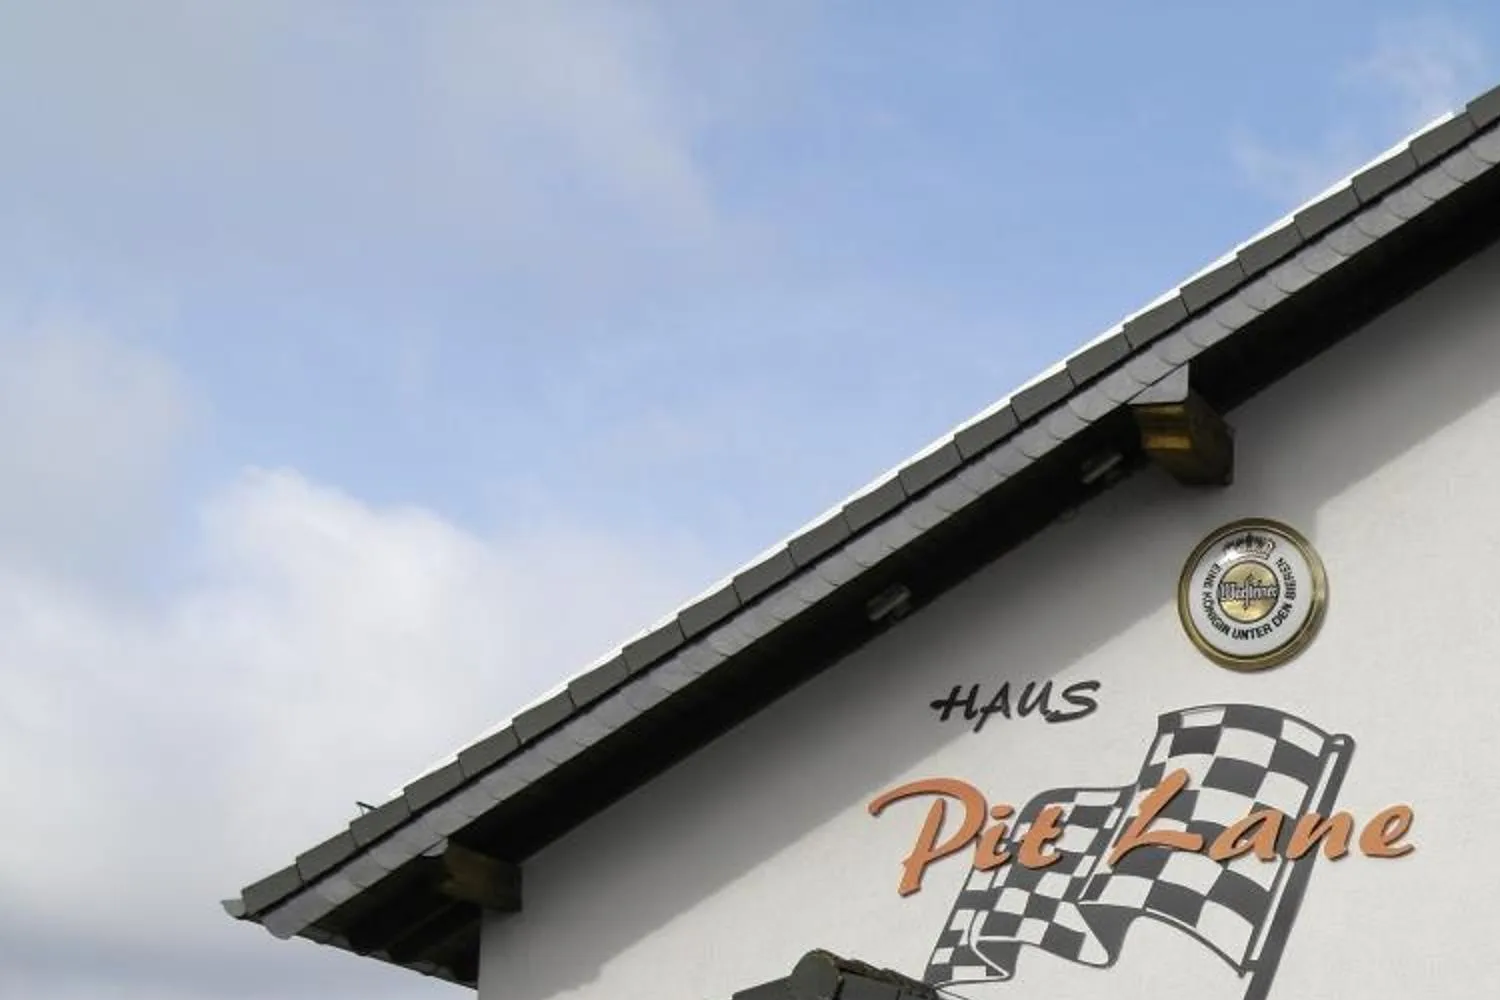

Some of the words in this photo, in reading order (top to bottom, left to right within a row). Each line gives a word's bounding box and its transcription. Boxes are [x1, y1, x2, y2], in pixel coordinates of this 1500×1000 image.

[1202, 563, 1222, 587] EINE
[1231, 623, 1273, 640] UNTER
[1271, 603, 1293, 628] DEN
[930, 680, 1100, 732] HAUS
[867, 776, 1067, 897] Pit
[1106, 768, 1415, 868] Lane
